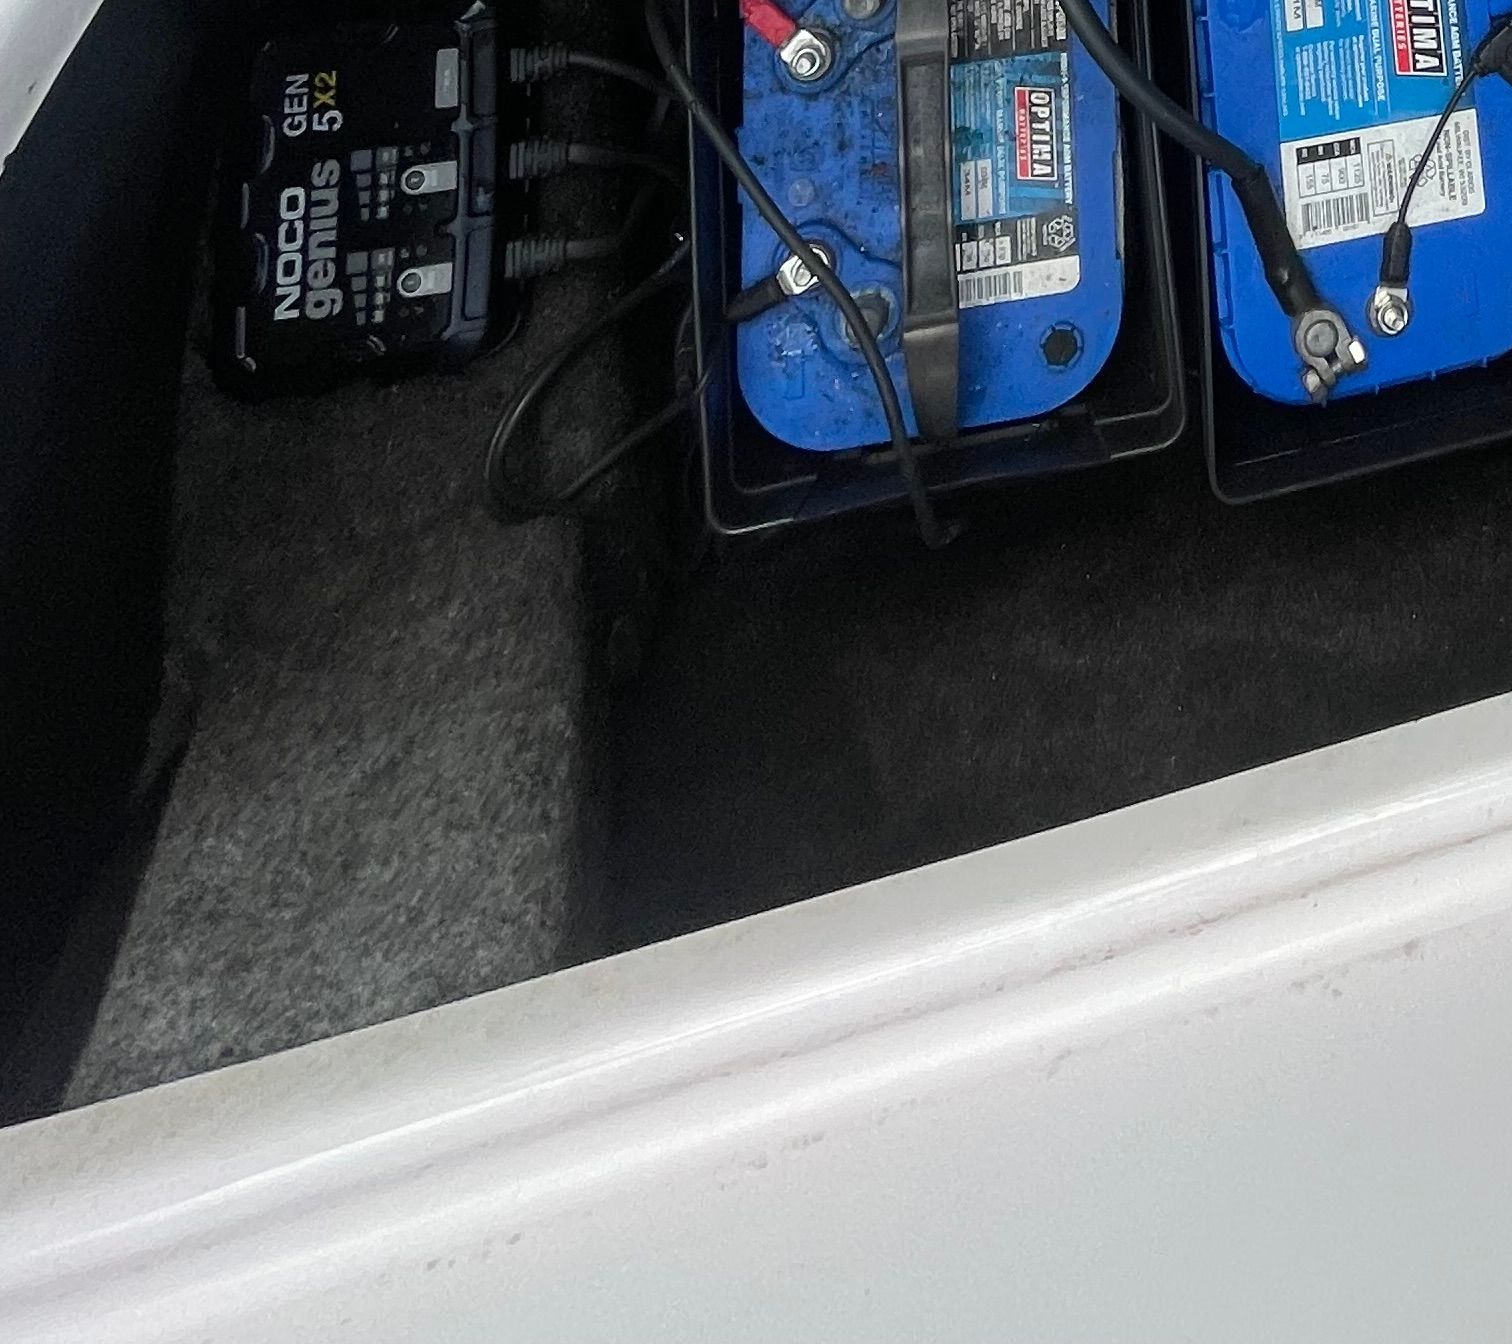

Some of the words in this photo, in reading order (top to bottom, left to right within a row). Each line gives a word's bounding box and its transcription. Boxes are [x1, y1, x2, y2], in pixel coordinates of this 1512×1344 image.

[1371, 29, 1381, 54] DUAL
[1449, 25, 1460, 50] AGM
[281, 73, 309, 137] GEN
[1373, 55, 1386, 101] PURPOSE
[1030, 92, 1052, 176] OPTIMA
[1443, 129, 1457, 201] NON-SPILLABLE
[273, 186, 306, 320] NOCO
[304, 159, 343, 320] genius
